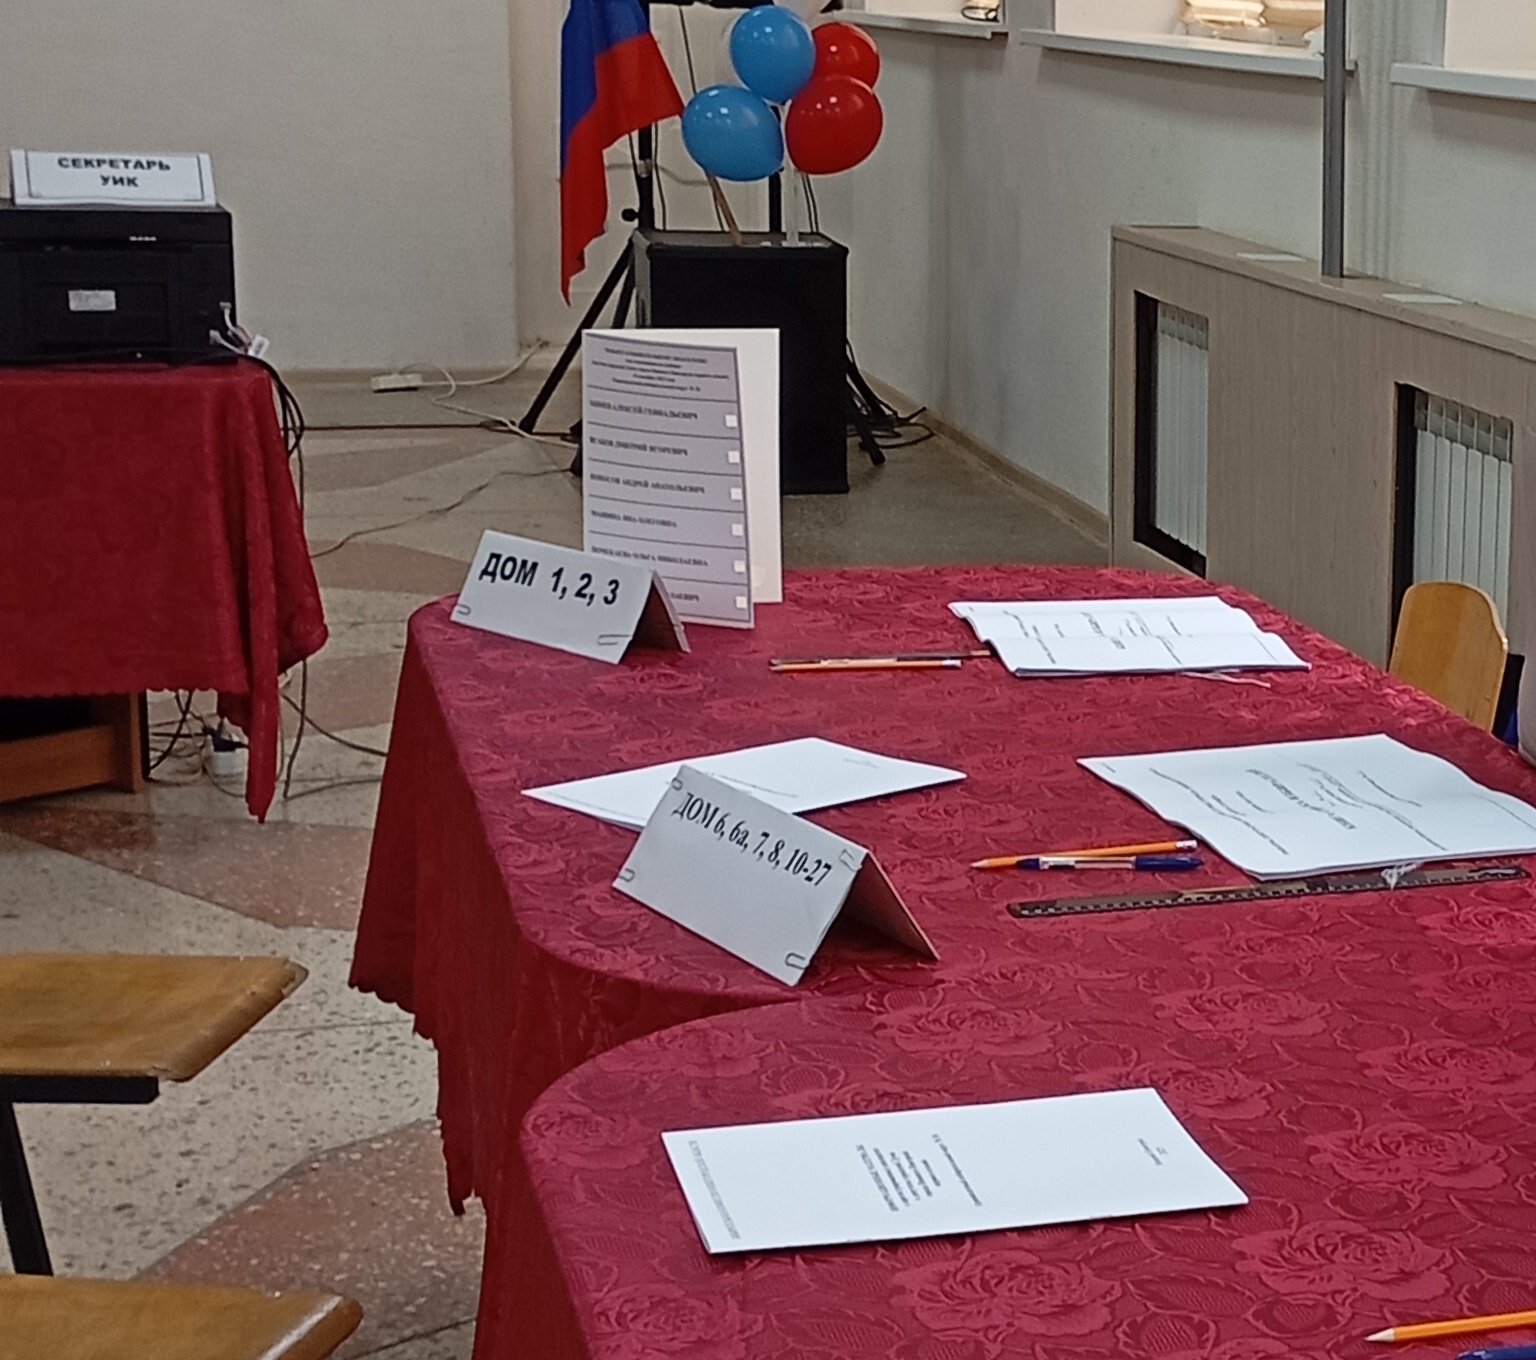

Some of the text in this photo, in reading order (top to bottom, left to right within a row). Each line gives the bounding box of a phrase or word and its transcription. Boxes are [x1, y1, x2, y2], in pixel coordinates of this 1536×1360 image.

[57, 157, 171, 172] СЕКРЕТАРЬ
[100, 175, 139, 188] УИК
[478, 552, 620, 607] ДОМ 1, 2, 3
[671, 791, 833, 886] ДОМ 6, 6а, 7, 8, 10-27
